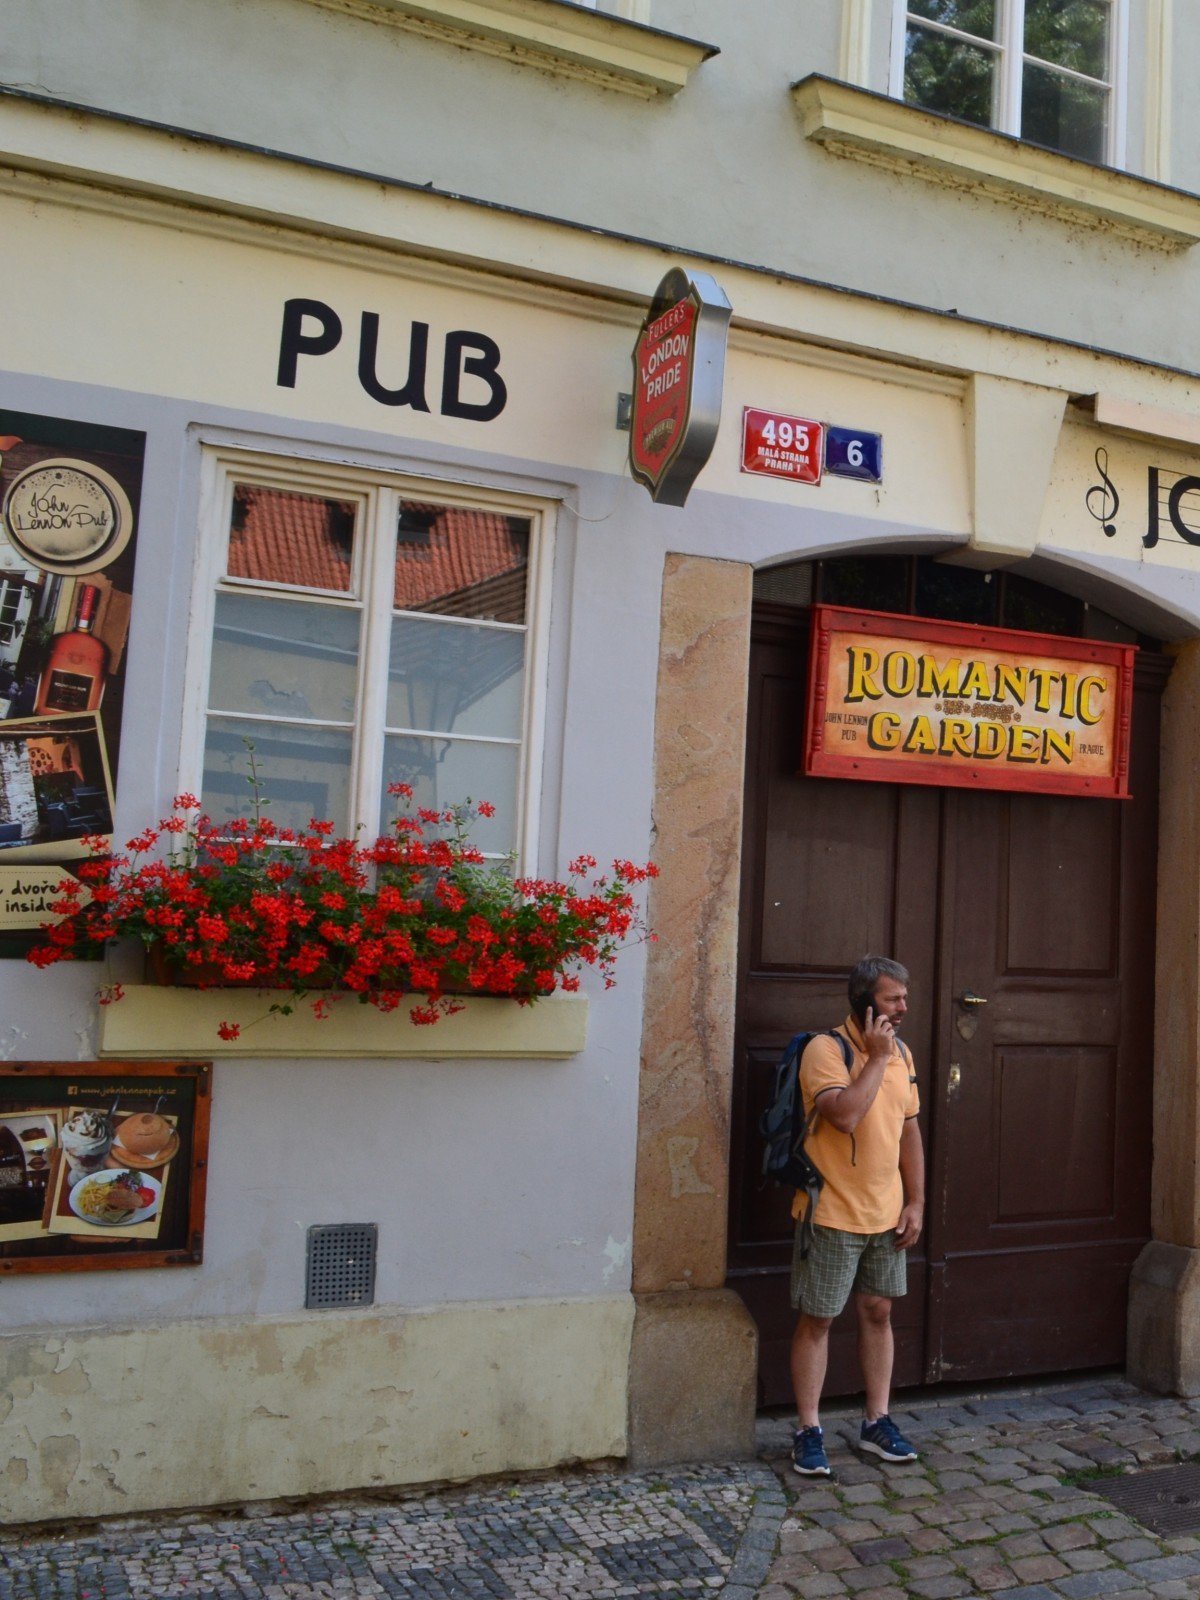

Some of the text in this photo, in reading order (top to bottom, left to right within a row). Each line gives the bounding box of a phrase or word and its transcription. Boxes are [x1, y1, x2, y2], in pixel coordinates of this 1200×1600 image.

[648, 304, 686, 341] FULLER'S
[276, 298, 508, 422] PUB
[642, 334, 689, 384] LONDON
[647, 362, 681, 403] PRIDE
[761, 419, 810, 452] 495
[757, 446, 810, 465] MALÁ STRANA
[764, 459, 801, 473] PRAHA 1
[847, 440, 863, 467] 6
[844, 646, 1107, 726] ROMANTIC
[825, 712, 868, 726] JOHN LENNON
[841, 729, 857, 741] PUB
[867, 712, 1075, 764] GARDEN
[1079, 743, 1104, 756] PRAGUE
[11, 880, 59, 895] dvoře
[5, 896, 55, 913] inside
